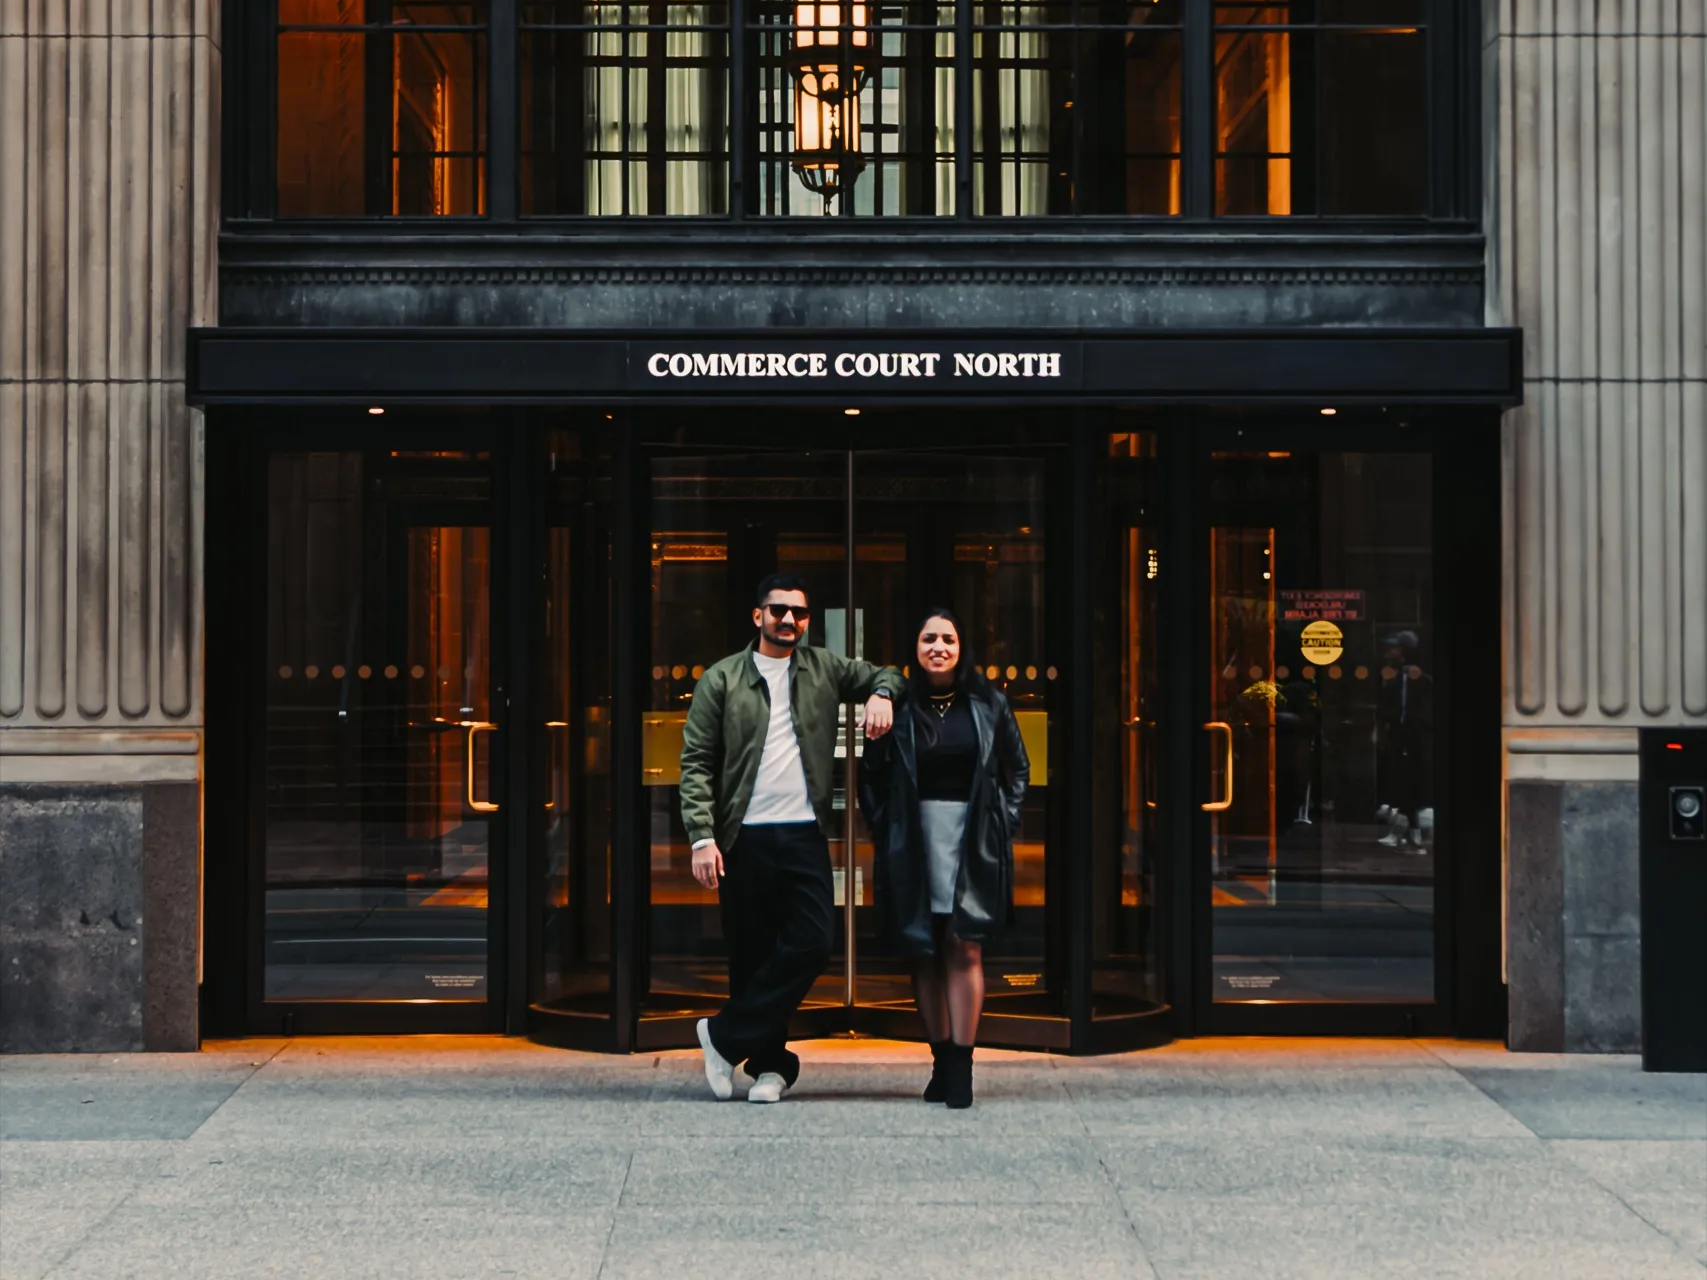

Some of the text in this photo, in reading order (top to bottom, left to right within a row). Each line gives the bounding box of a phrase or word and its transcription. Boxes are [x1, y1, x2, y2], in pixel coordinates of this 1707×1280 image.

[647, 352, 1062, 378] COMMERCE COURT NORTH
[1301, 638, 1342, 648] CAUTION
